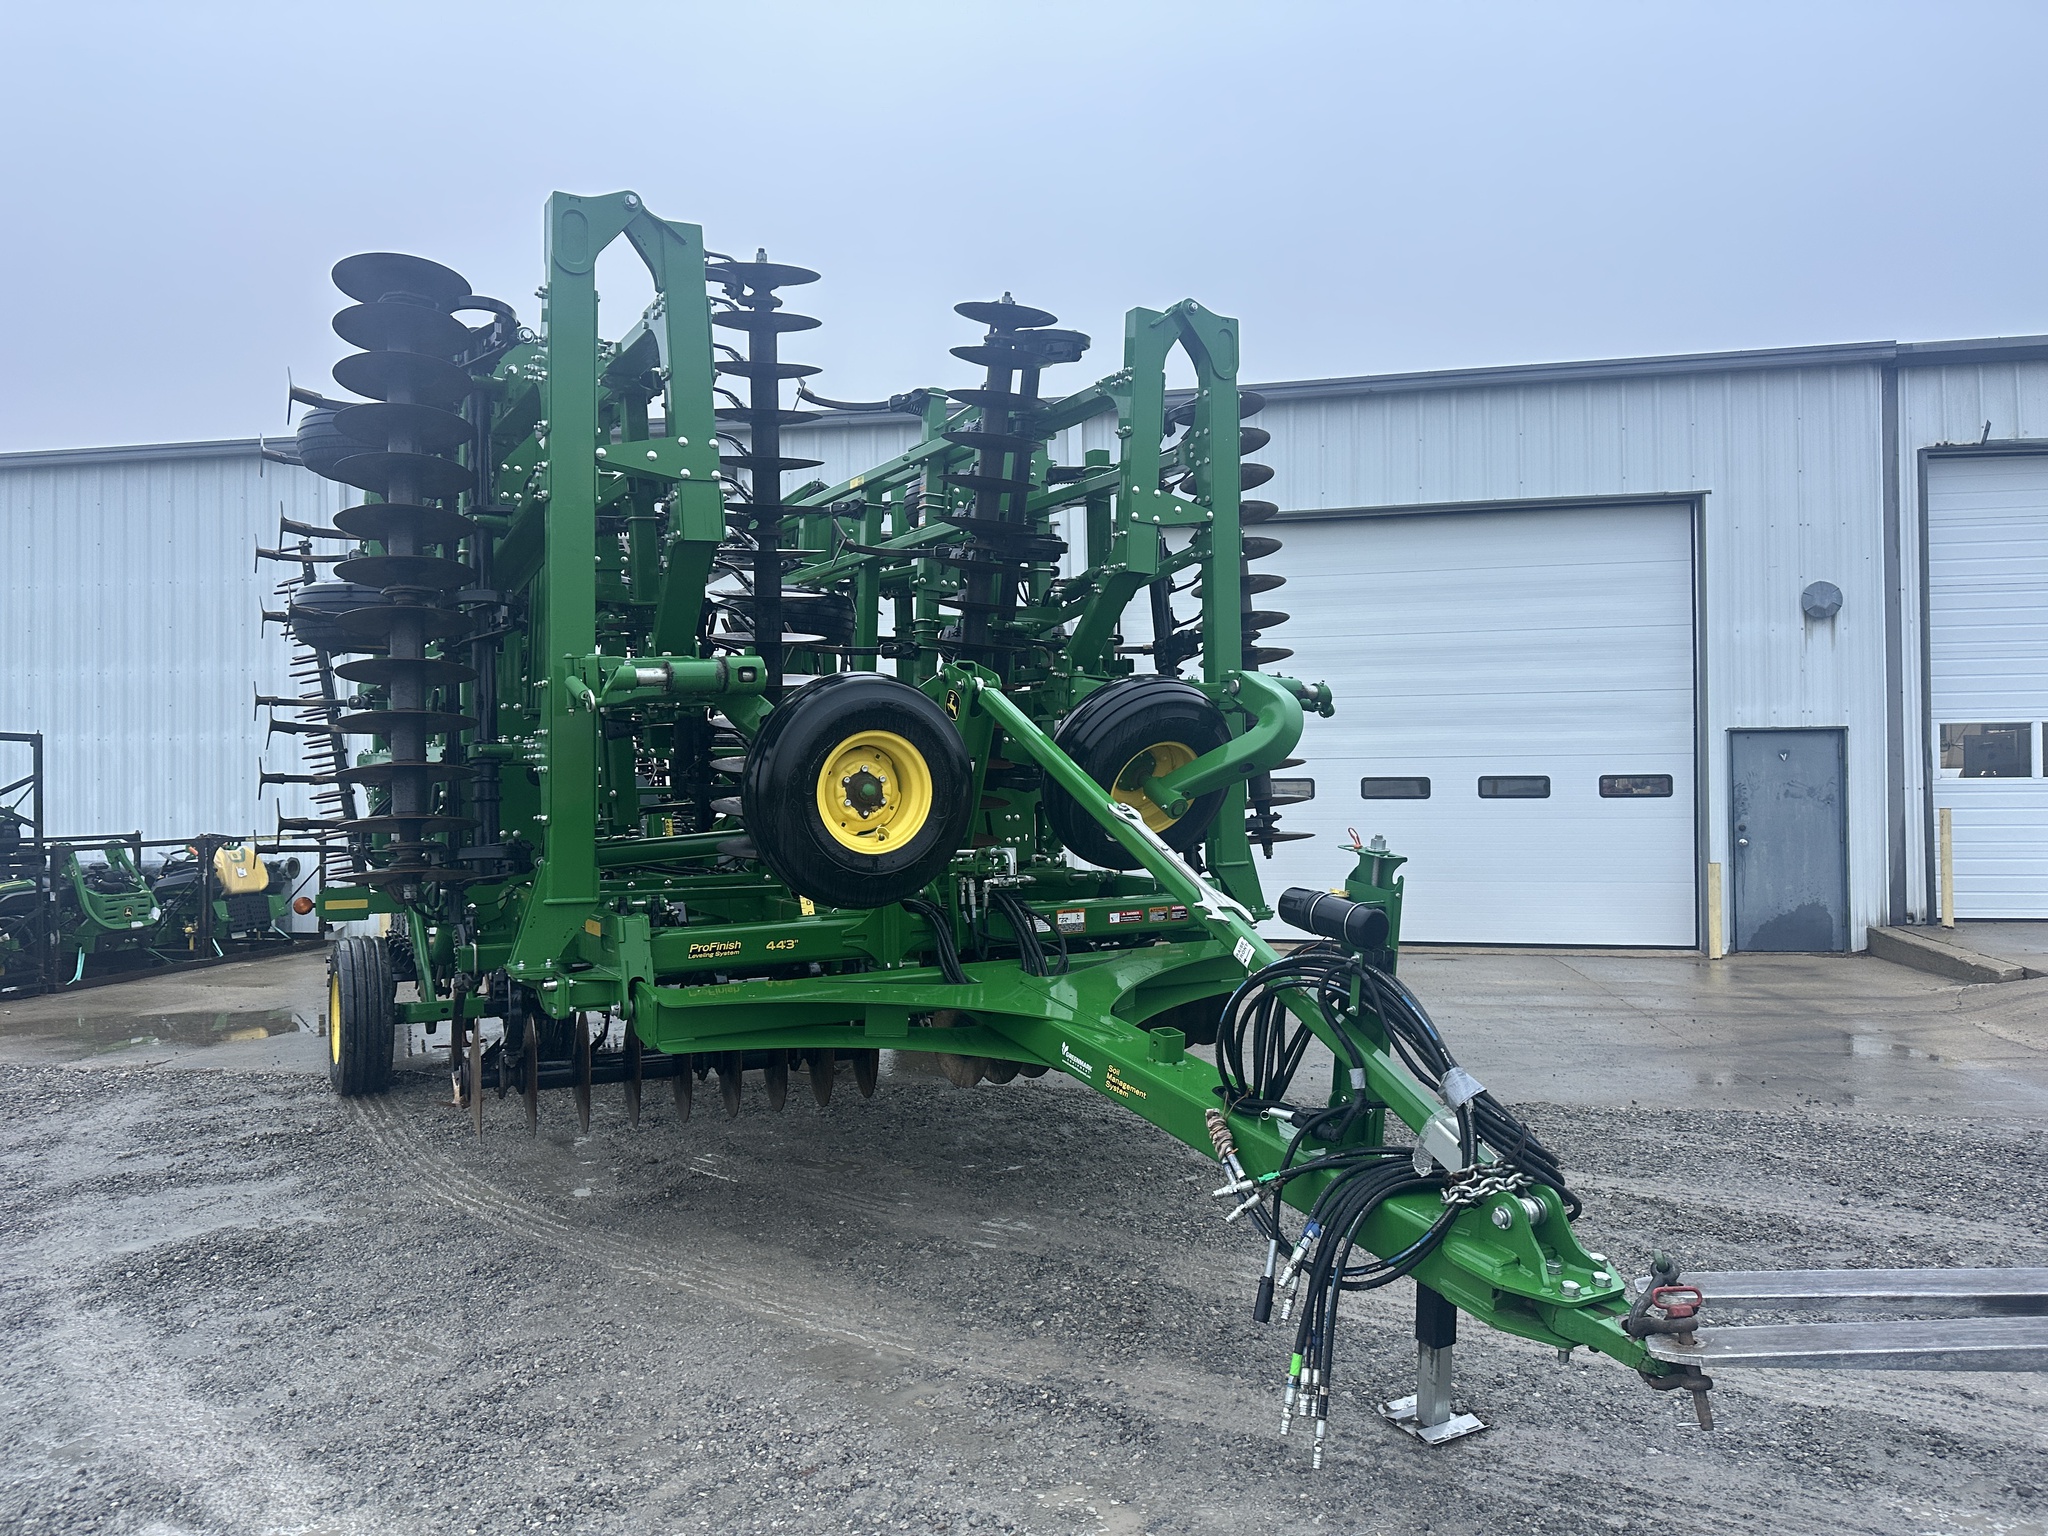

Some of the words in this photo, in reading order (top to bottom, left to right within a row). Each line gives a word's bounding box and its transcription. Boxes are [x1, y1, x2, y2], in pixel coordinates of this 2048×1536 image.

[689, 940, 742, 953] ProFinish
[687, 951, 715, 959] Leveling
[714, 948, 740, 957] System
[1108, 1064, 1121, 1076] Soil
[1105, 1080, 1129, 1098] System
[1106, 1072, 1147, 1099] Management
